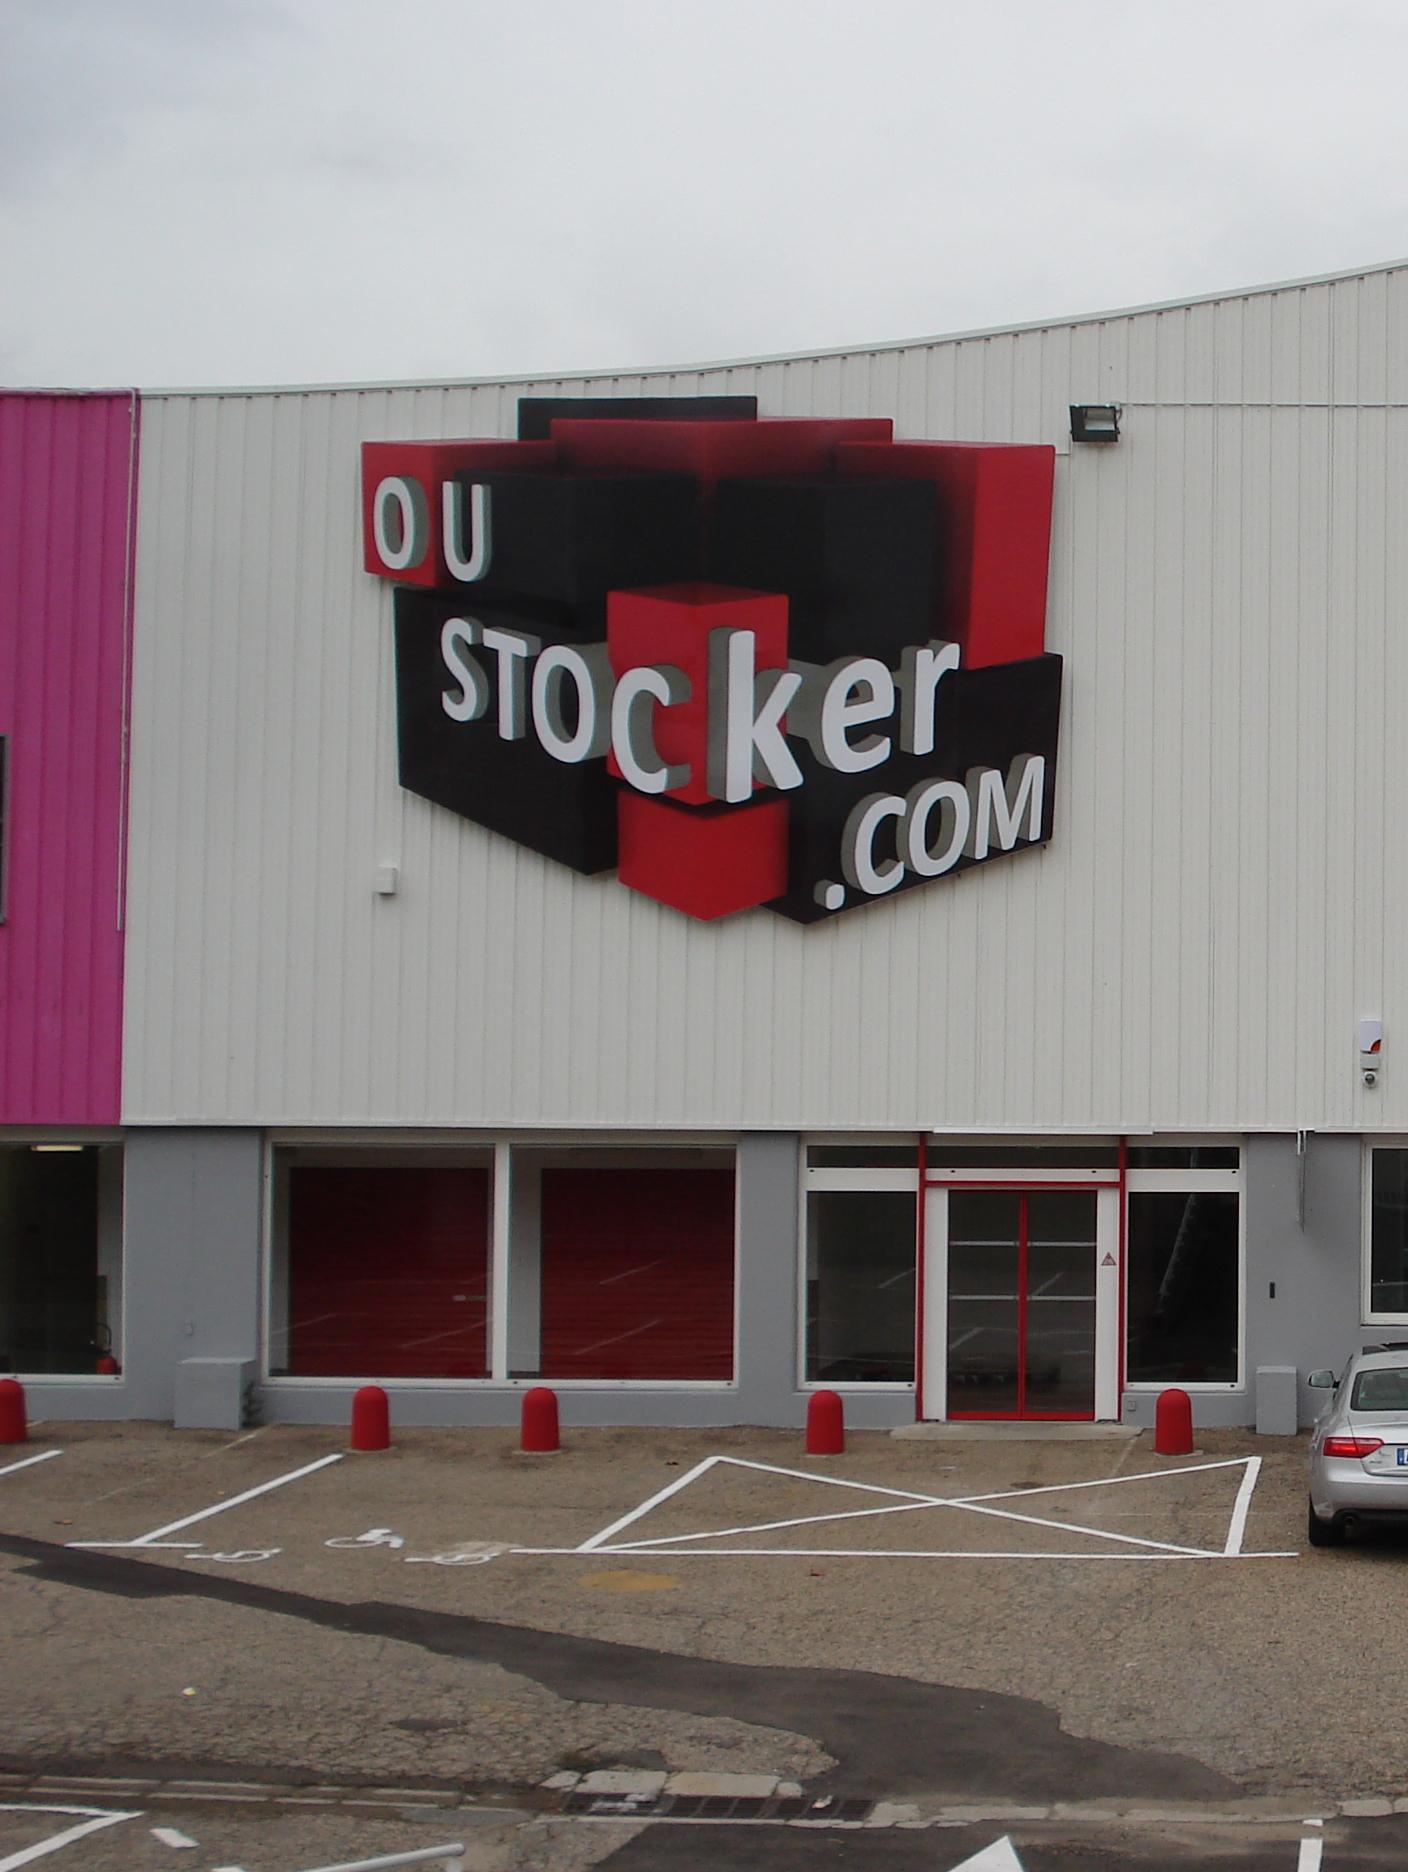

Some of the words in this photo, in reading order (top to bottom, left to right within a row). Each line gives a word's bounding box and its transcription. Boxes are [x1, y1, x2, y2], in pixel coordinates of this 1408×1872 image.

[372, 476, 492, 583] OU
[440, 626, 961, 804] STOcker
[820, 753, 1046, 911] .COM
